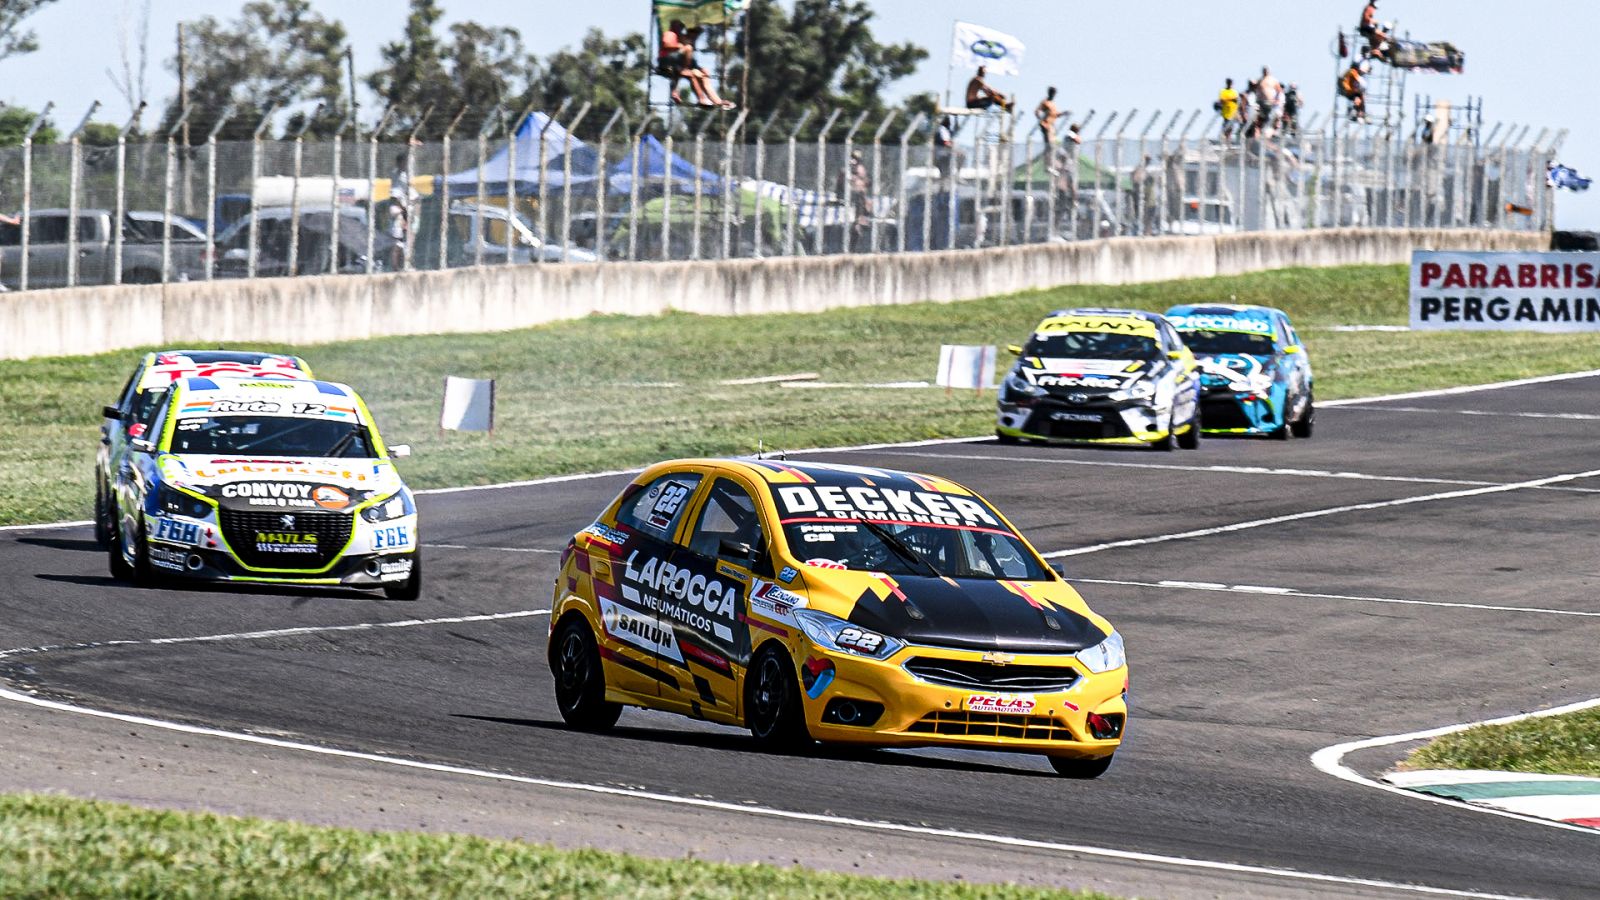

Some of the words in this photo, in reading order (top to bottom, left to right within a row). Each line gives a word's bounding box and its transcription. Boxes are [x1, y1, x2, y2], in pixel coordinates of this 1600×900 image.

[1420, 263, 1600, 288] PARABRIS
[208, 400, 281, 413] Ruta
[293, 402, 327, 415] 12
[221, 483, 312, 498] CONVOY
[654, 485, 688, 514] 22
[778, 486, 999, 526] DECKER
[833, 510, 960, 526] CAMIONES
[155, 518, 199, 544] FGH
[373, 526, 409, 548] FGH
[625, 549, 736, 621] LAROCCA
[779, 566, 798, 584] 22
[642, 593, 712, 632] NEUMÁTICOS
[619, 613, 672, 648] SAILUN
[836, 627, 883, 652] 22
[971, 705, 1031, 713] AUTOMOTORES
